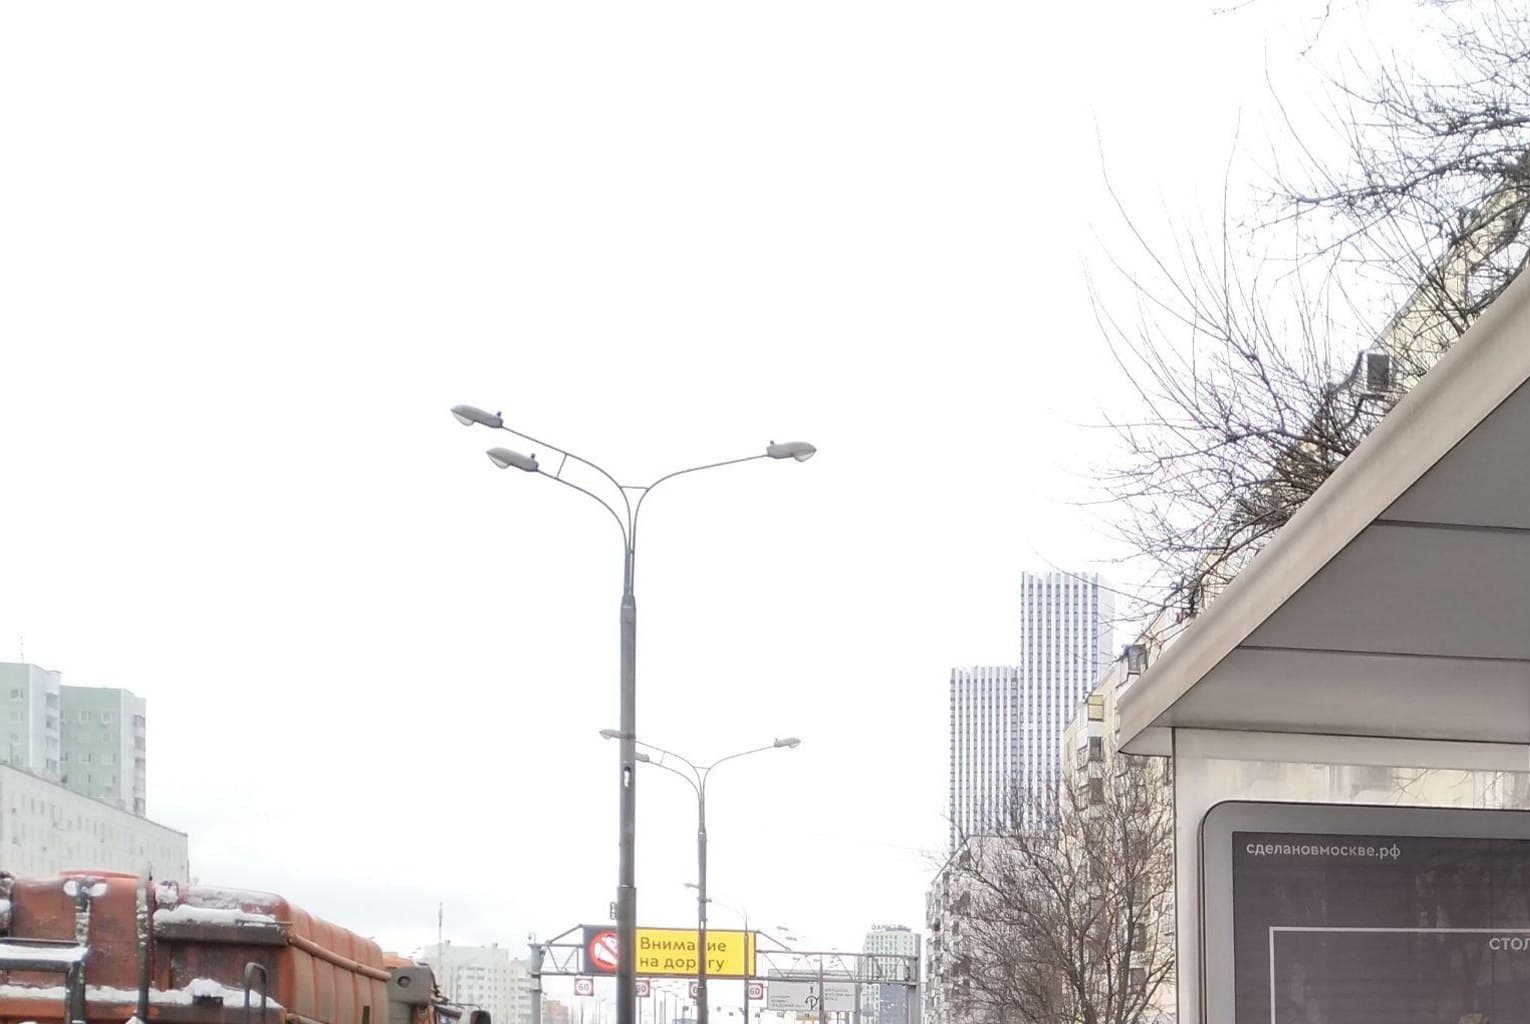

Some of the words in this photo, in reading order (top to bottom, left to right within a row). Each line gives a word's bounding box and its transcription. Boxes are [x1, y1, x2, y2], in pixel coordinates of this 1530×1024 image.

[1246, 842, 1401, 860] сделановмоскве.рф
[640, 936, 727, 951] Внимаие
[640, 958, 659, 967] на
[663, 959, 725, 972] доргу
